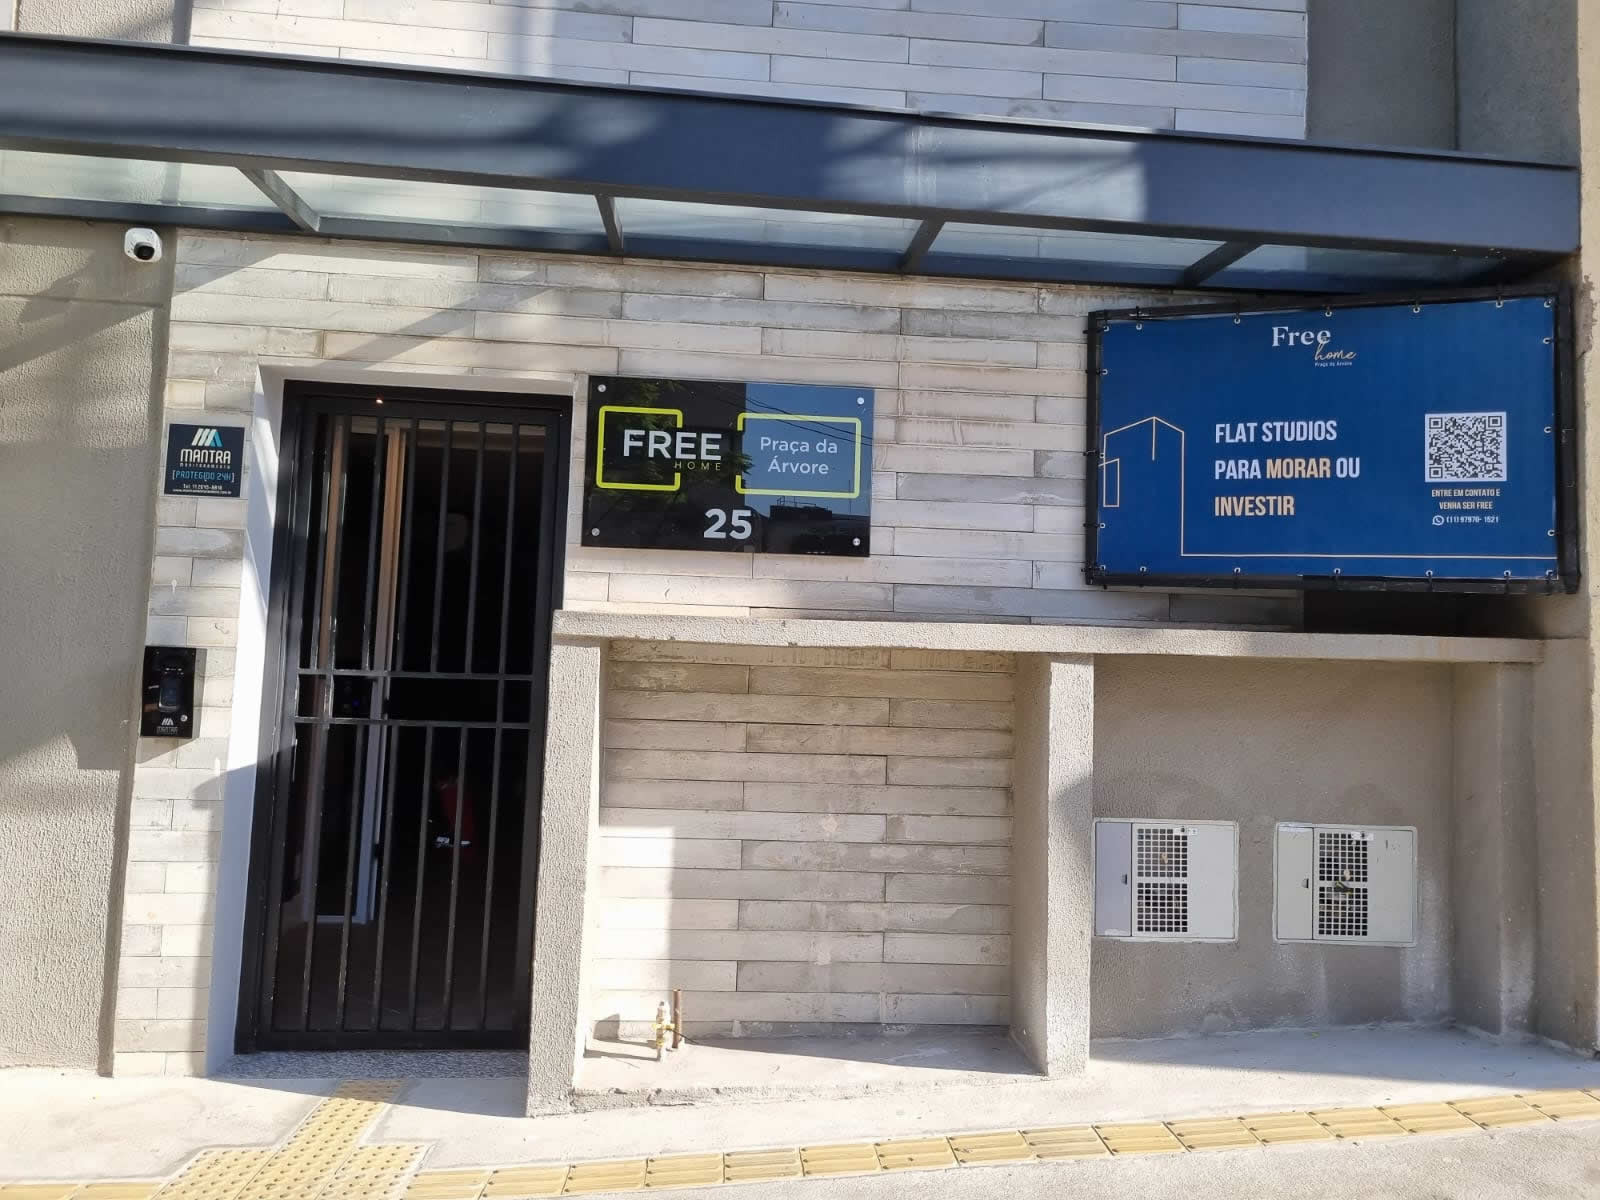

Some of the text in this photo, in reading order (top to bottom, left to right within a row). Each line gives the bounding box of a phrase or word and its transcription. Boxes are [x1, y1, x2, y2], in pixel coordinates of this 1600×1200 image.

[1272, 326, 1331, 347] Free
[1314, 339, 1357, 361] home
[1215, 420, 1338, 443] FLAT STUDIOS
[623, 429, 723, 461] FREE
[760, 437, 838, 455] Praça da
[180, 448, 231, 464] MANTRA
[674, 460, 722, 472] HOME
[768, 457, 829, 475] Árvore
[1214, 457, 1361, 480] PARA MORAR OU
[1431, 488, 1501, 497] ENTRE EM CONTATO E
[1214, 495, 1296, 517] INVESTIR
[1439, 501, 1494, 510] VENHA SER FREE
[703, 508, 752, 540] 25
